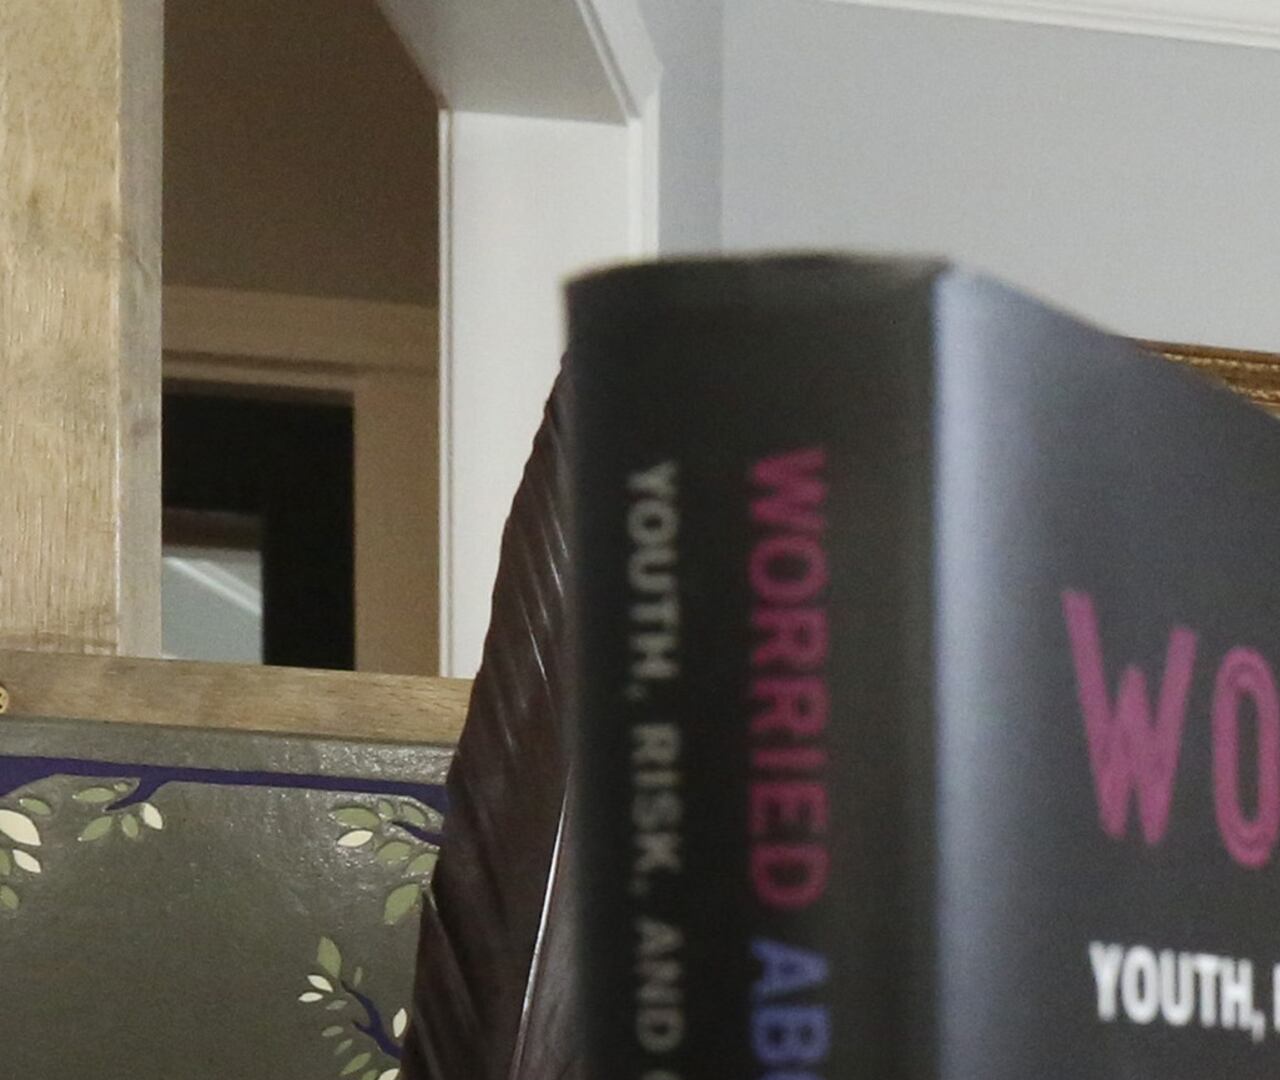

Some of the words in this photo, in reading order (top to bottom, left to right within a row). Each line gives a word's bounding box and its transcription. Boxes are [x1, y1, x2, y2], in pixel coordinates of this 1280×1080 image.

[627, 460, 680, 699] YOUTH,
[749, 447, 831, 908] WORRIED
[635, 917, 686, 1053] AND
[1088, 940, 1267, 1044] YOUTH,
